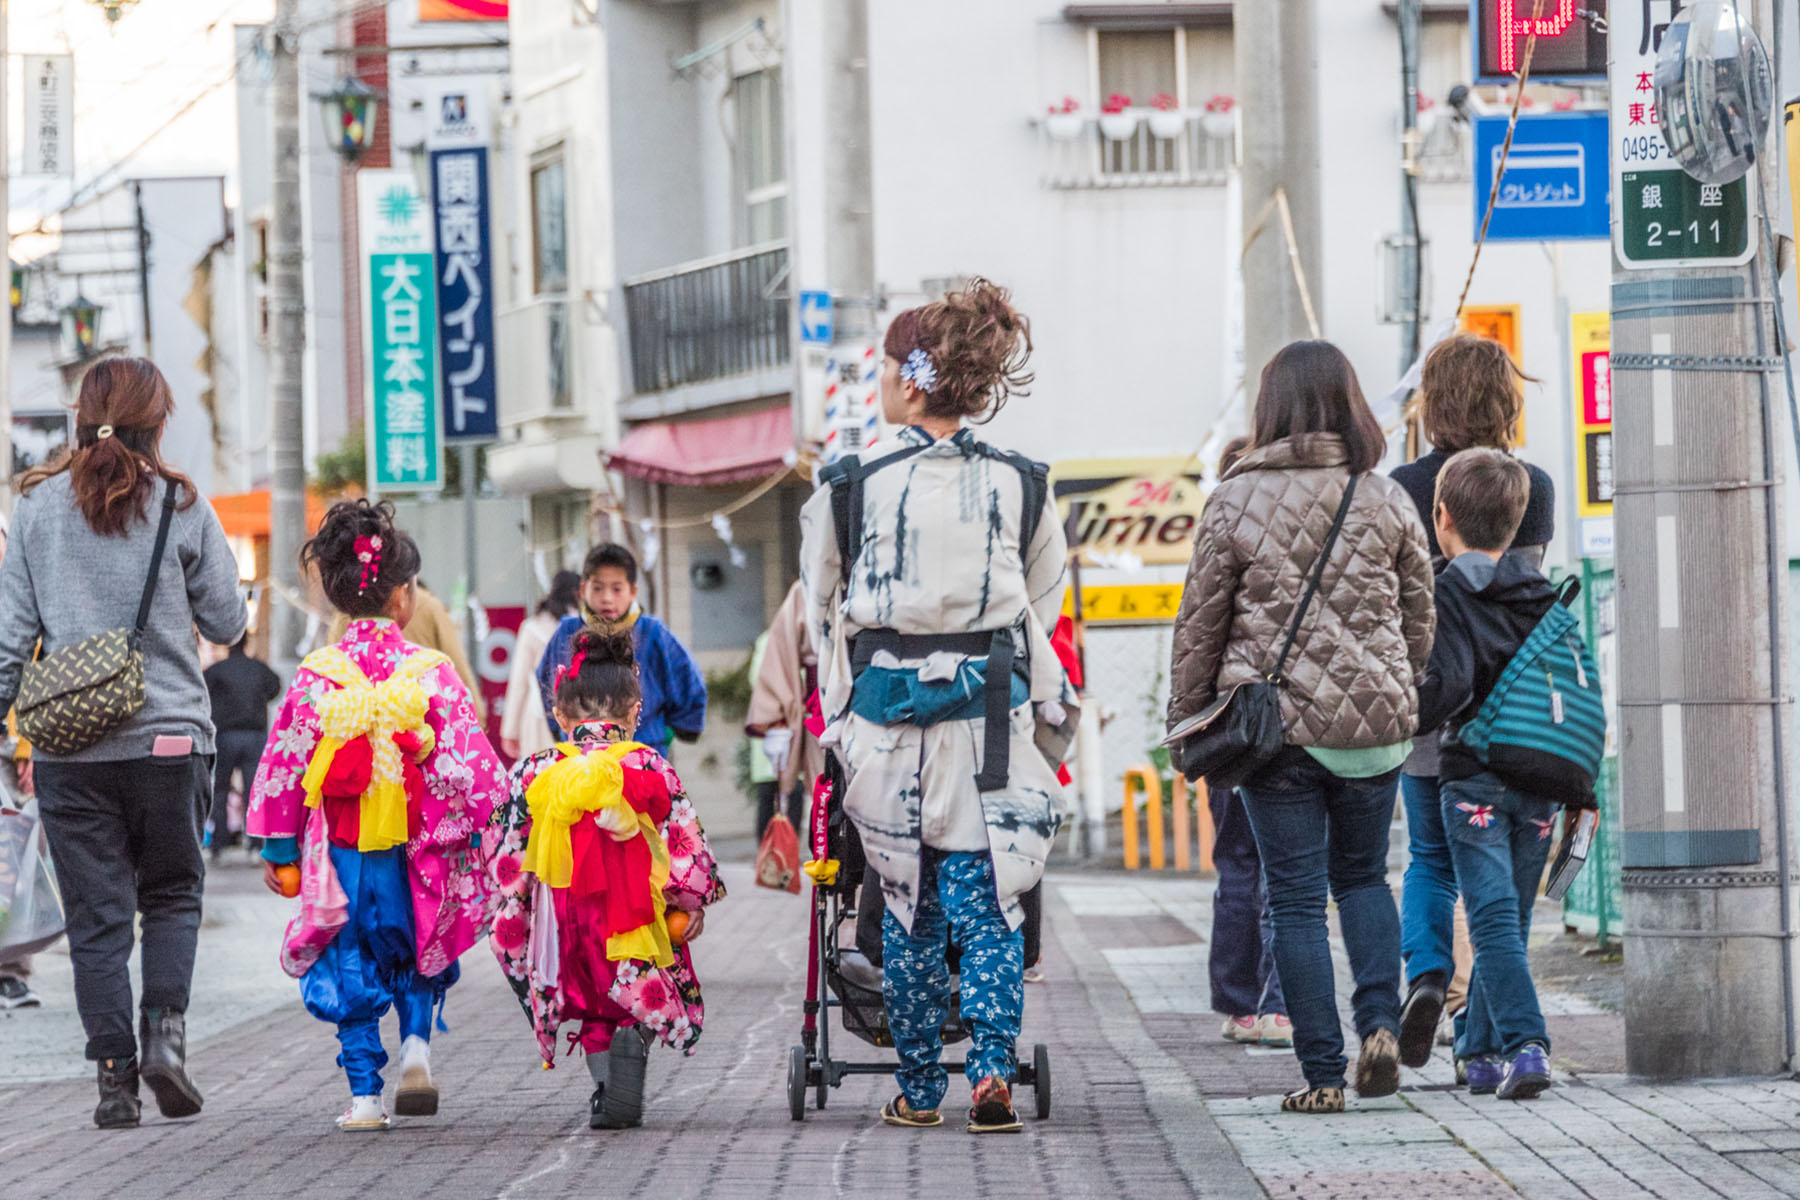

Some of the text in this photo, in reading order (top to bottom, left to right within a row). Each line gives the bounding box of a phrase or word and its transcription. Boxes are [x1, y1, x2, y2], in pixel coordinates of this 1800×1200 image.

[1636, 70, 1654, 94] 本
[1628, 102, 1660, 126] 東台
[1622, 136, 1673, 161] 0495-
[1503, 183, 1575, 201] クレジット
[1647, 219, 1721, 247] 2-11
[437, 153, 487, 432] 関西ペイント
[380, 255, 428, 482] 大日本塗料
[1063, 591, 1174, 614] イムズ
